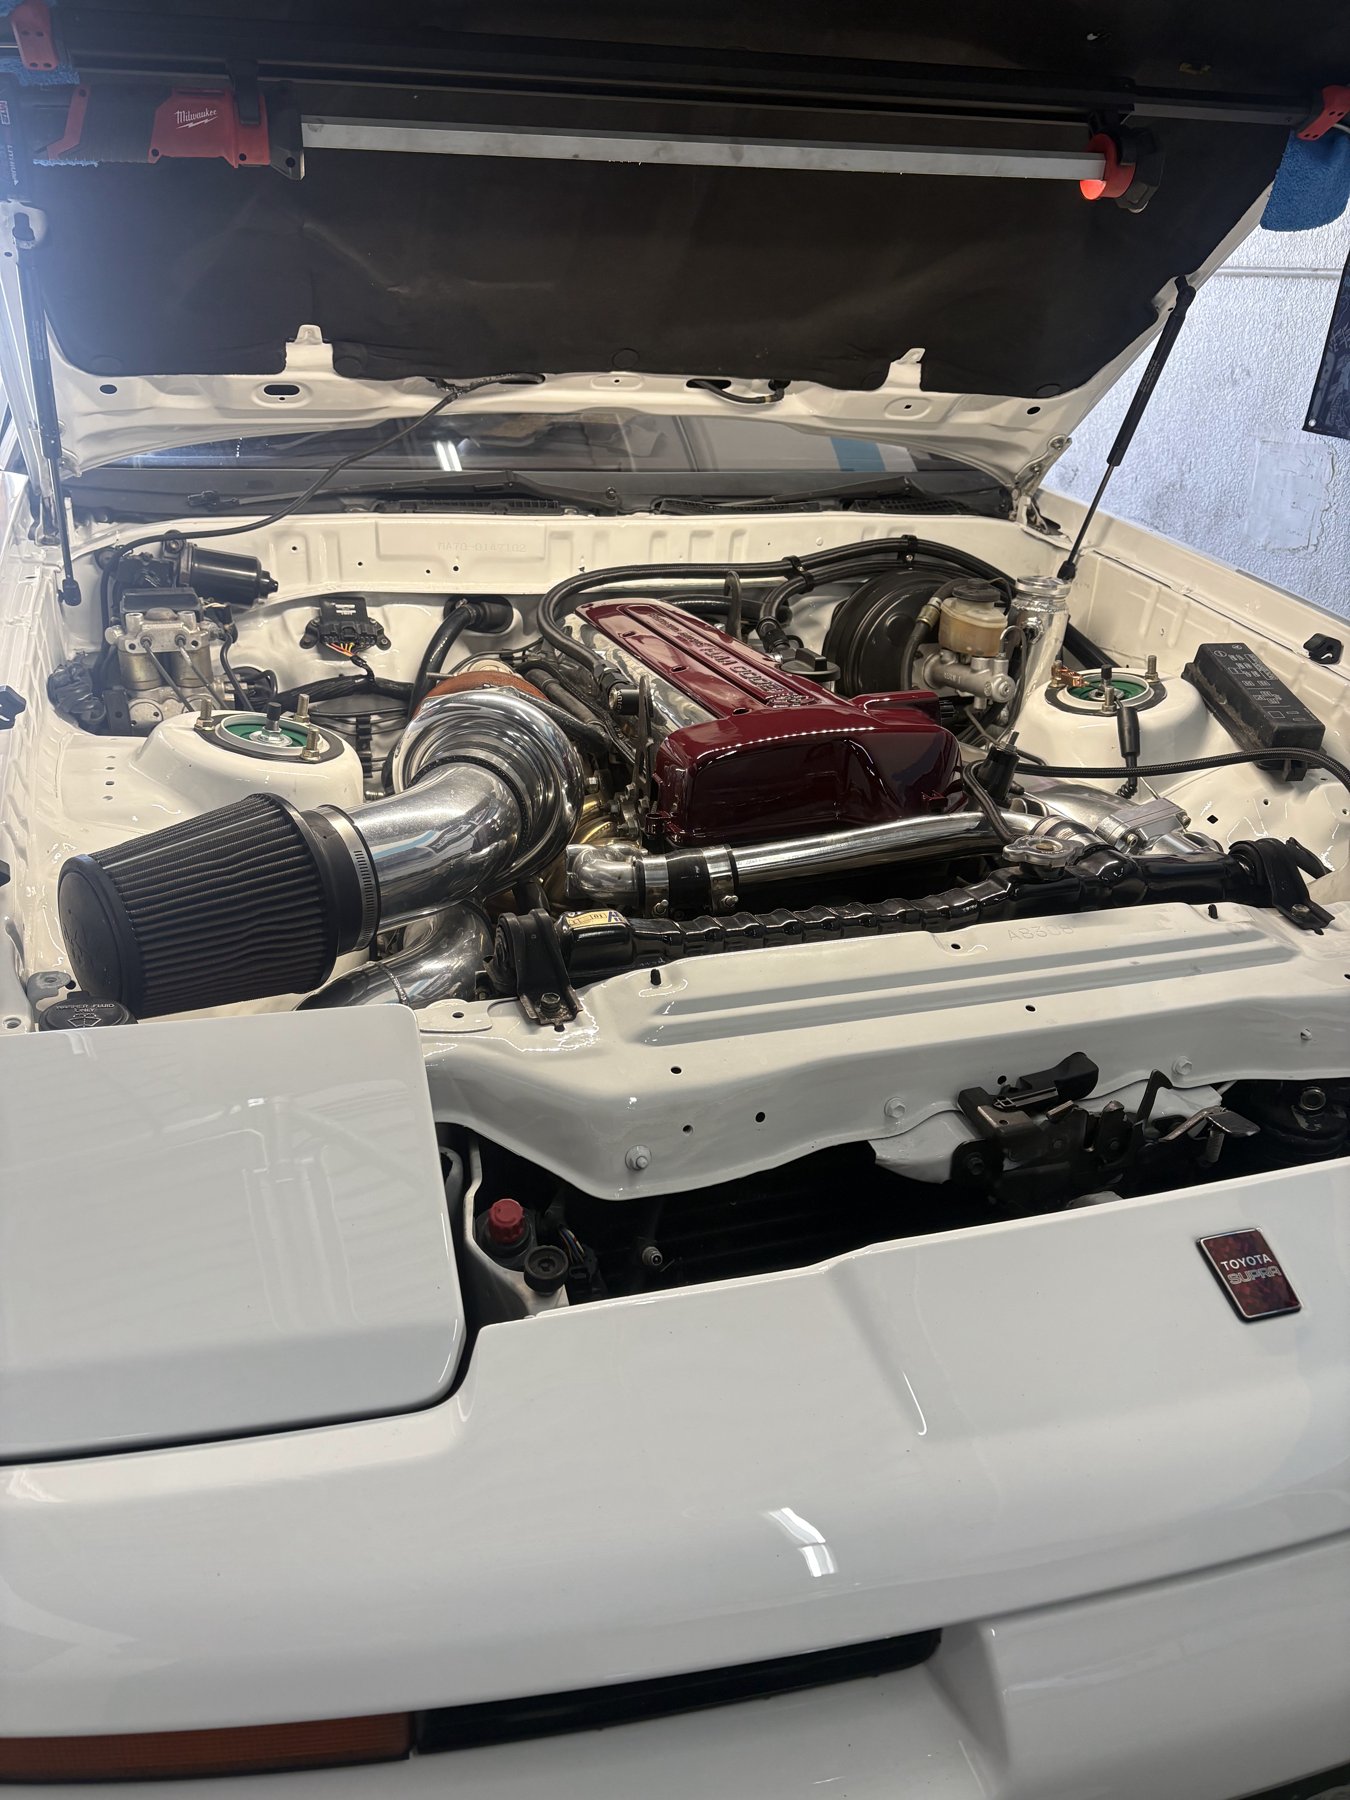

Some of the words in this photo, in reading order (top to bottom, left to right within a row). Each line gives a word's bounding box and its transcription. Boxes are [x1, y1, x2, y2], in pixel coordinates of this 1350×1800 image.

[175, 108, 217, 124] Milwaukee
[1220, 1253, 1272, 1271] TOYOTA
[1227, 1266, 1282, 1285] SUPRA
